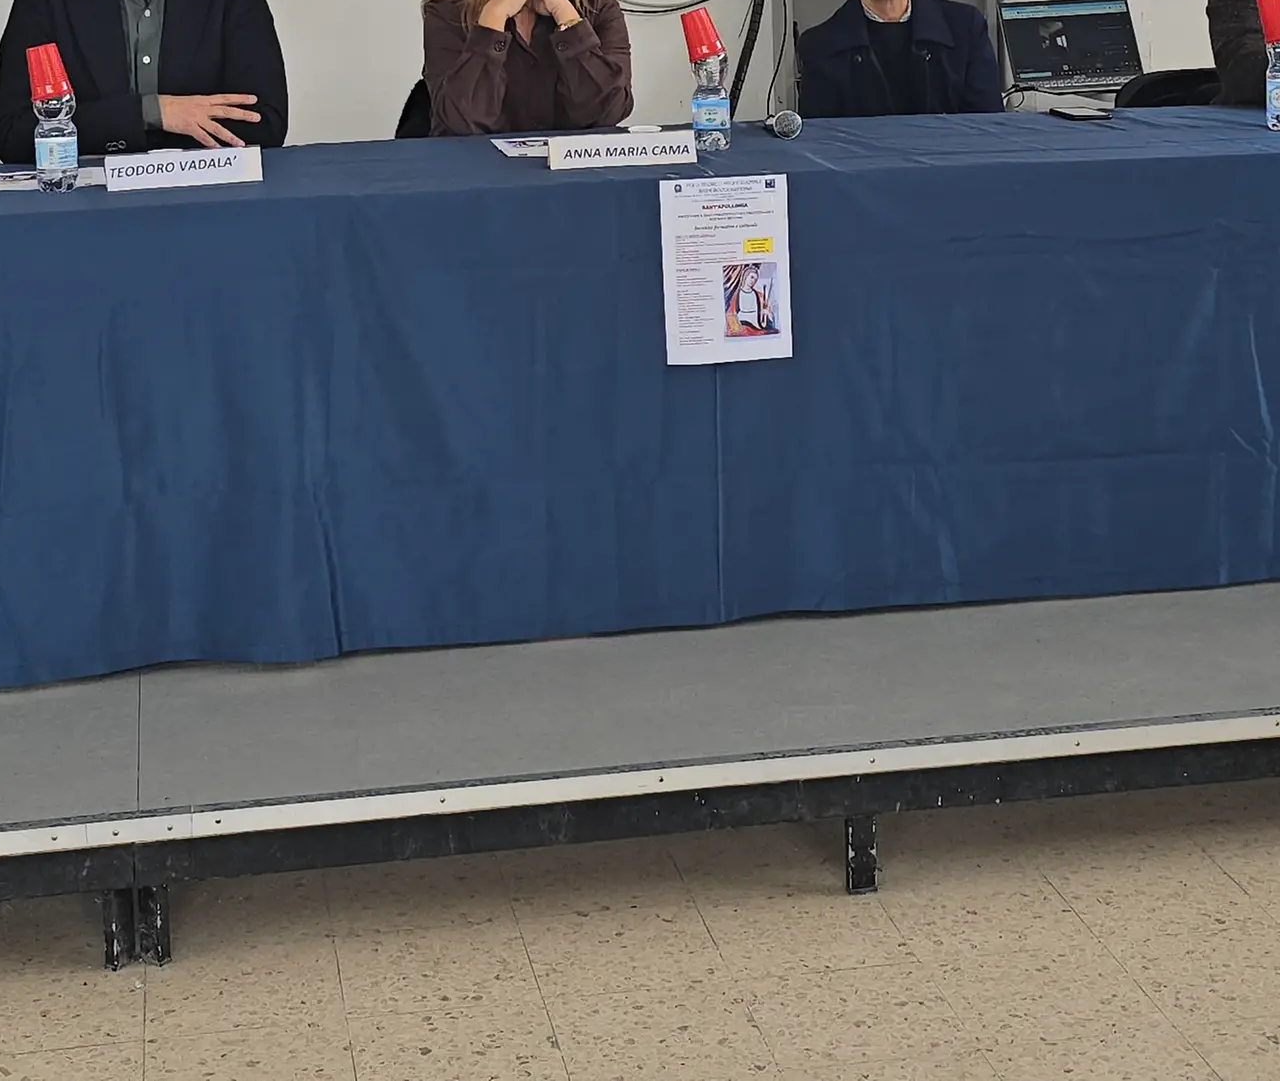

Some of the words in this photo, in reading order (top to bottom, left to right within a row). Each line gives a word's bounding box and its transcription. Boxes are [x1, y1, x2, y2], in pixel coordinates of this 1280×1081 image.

[564, 148, 601, 160] ANNA
[605, 146, 648, 158] MARIA
[652, 144, 690, 156] CAMA
[109, 162, 175, 179] TEODORO
